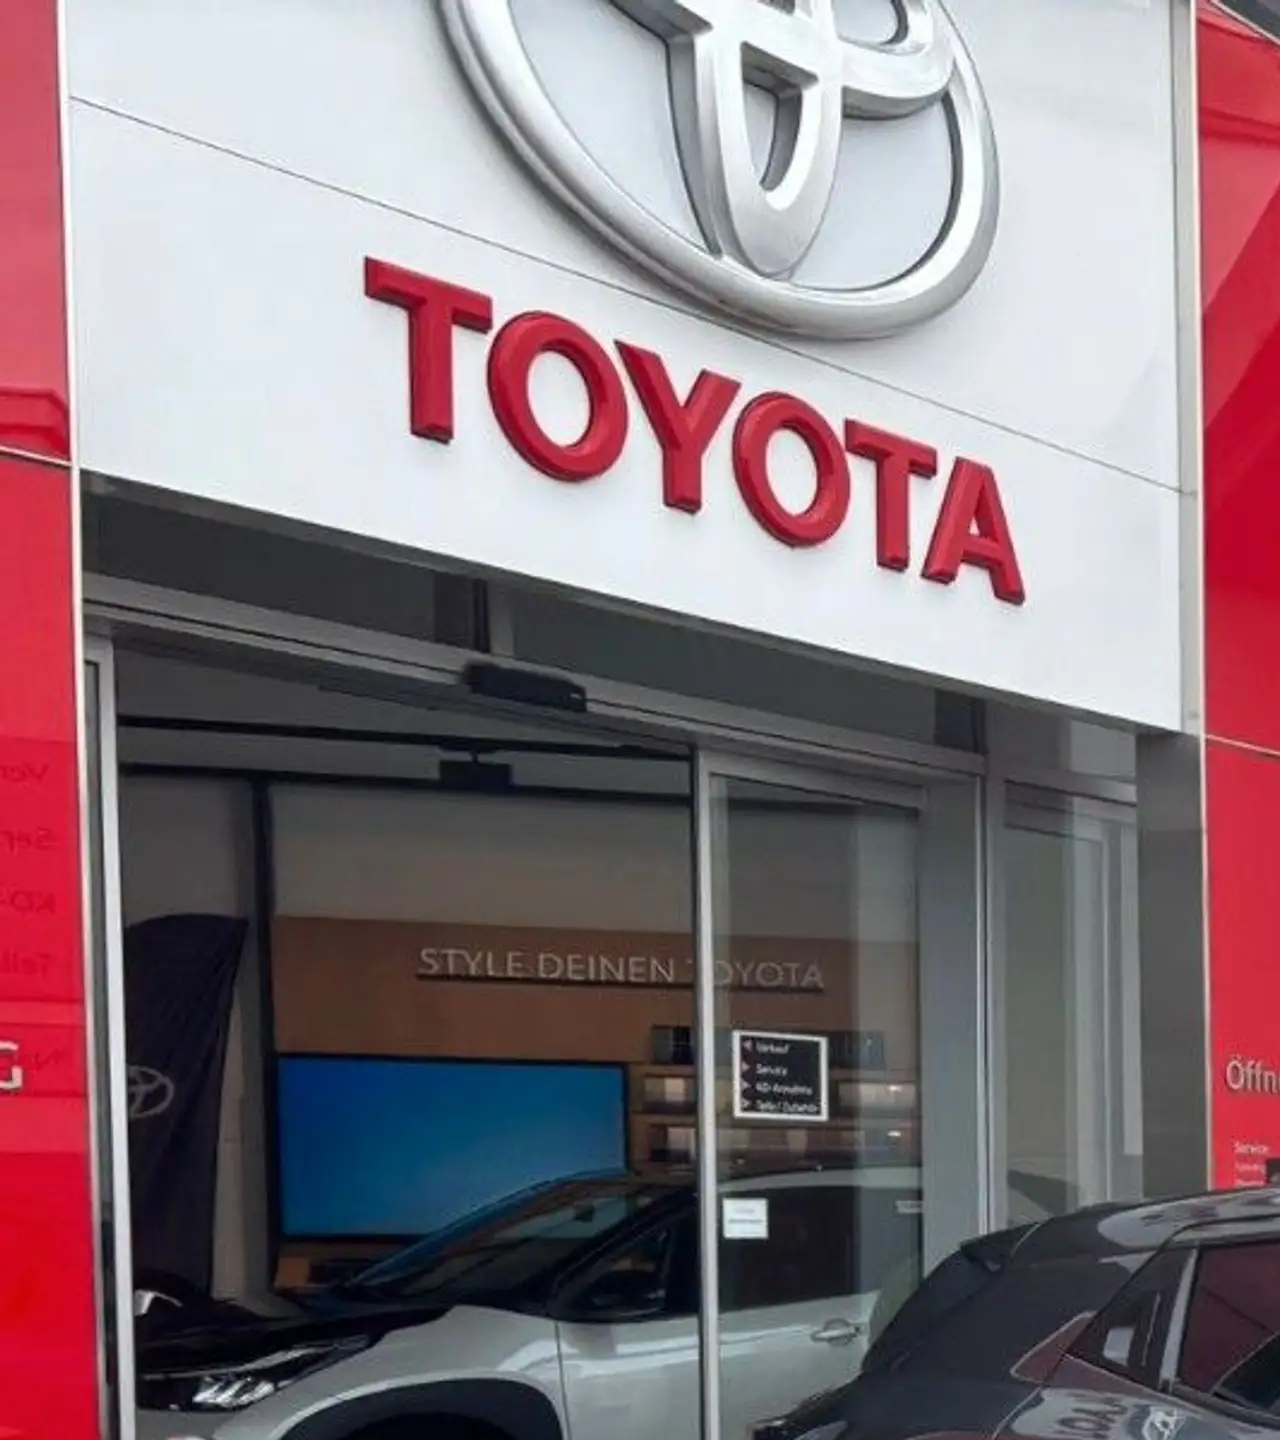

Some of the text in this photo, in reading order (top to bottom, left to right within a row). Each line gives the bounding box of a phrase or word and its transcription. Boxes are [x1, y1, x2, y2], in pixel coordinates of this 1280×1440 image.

[364, 255, 1025, 606] TOYOTA
[418, 947, 825, 989] STYLE DEINEN OYOTA
